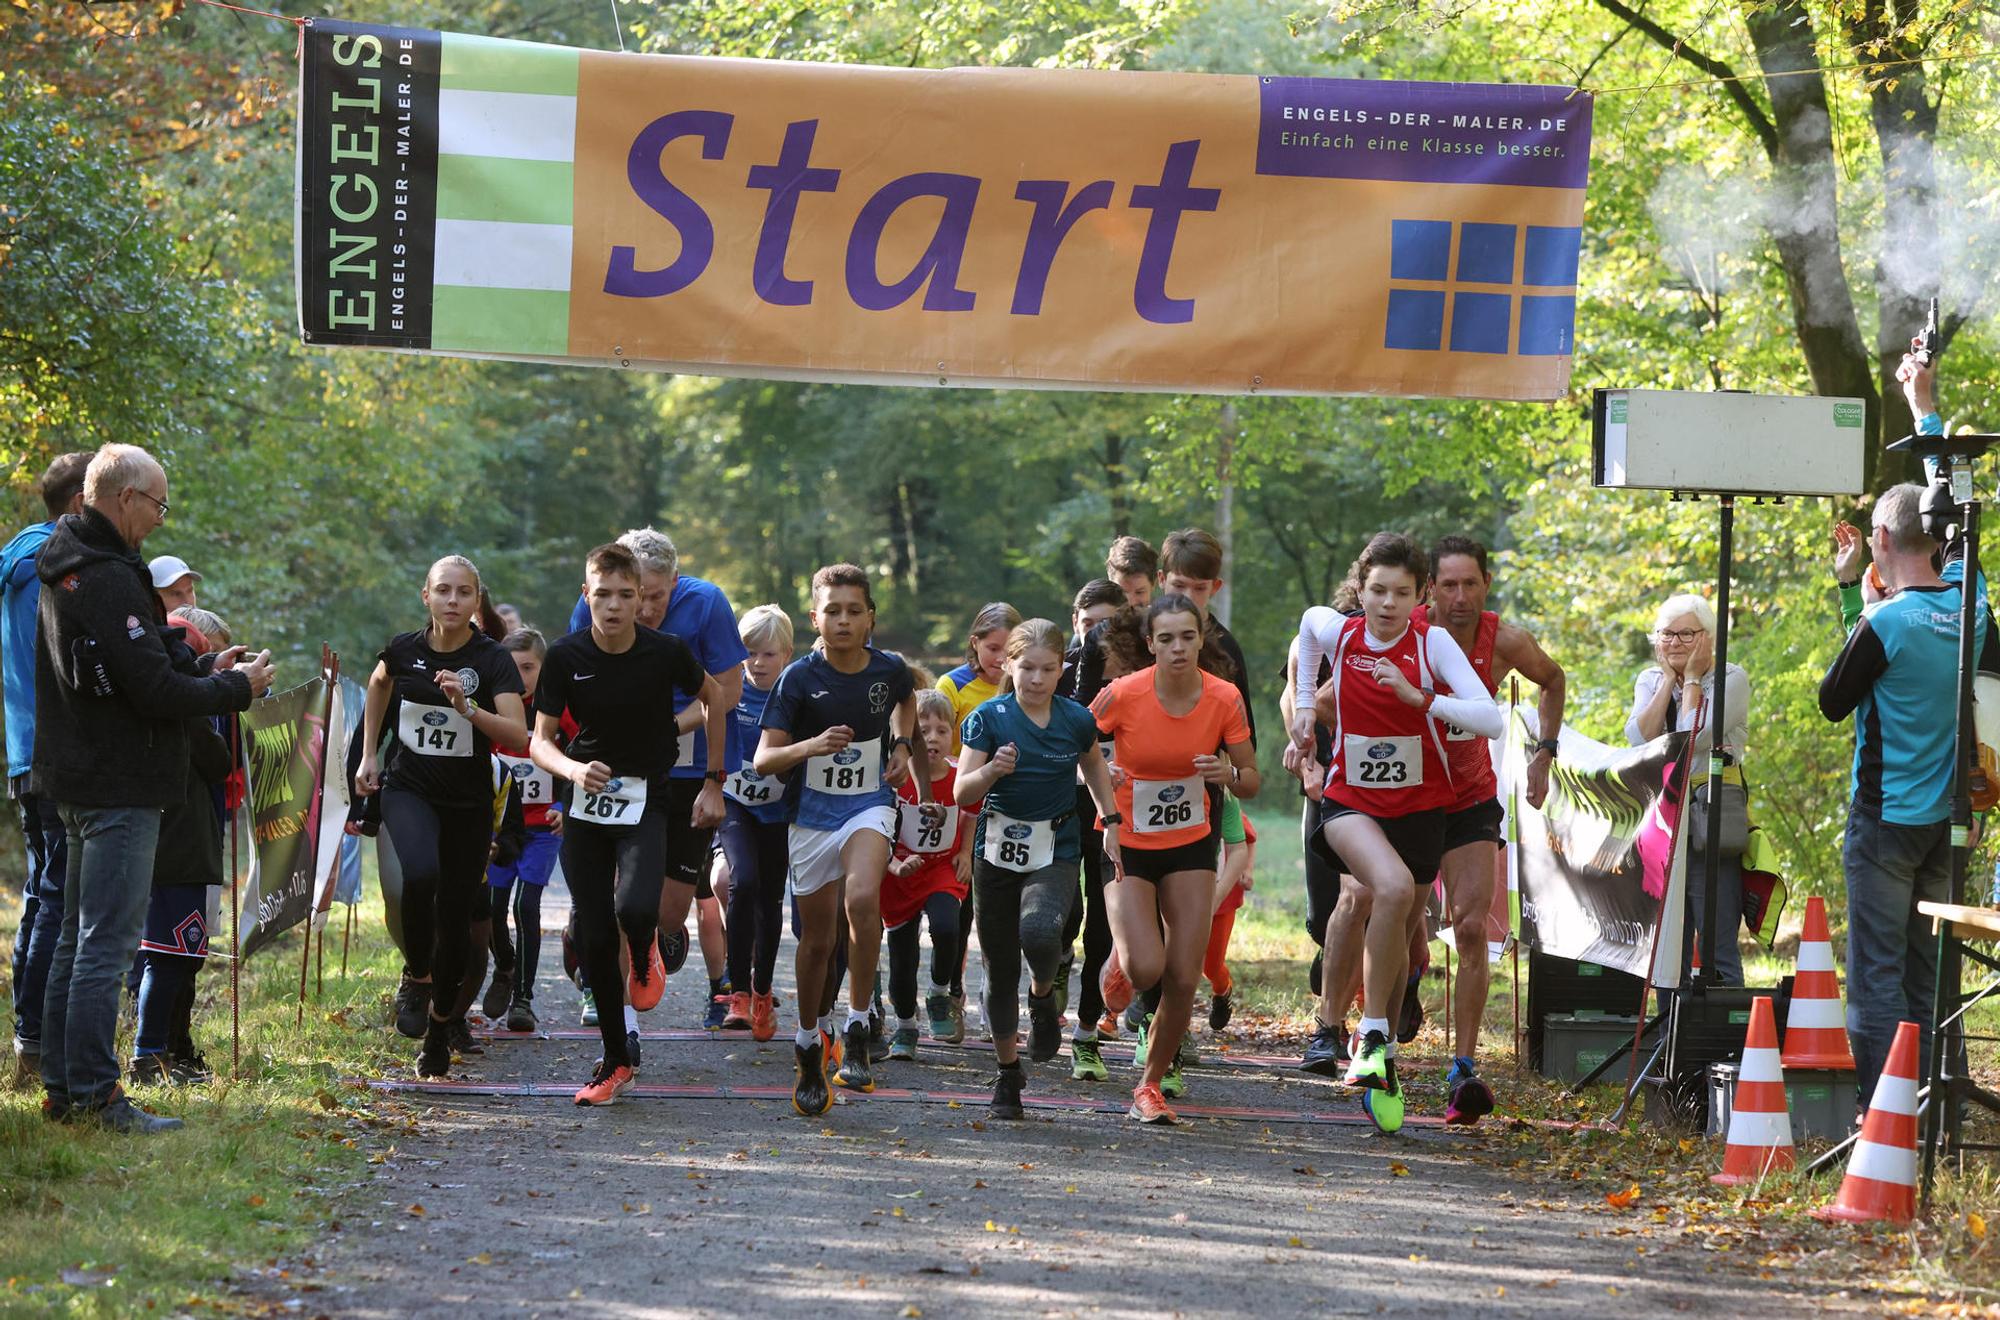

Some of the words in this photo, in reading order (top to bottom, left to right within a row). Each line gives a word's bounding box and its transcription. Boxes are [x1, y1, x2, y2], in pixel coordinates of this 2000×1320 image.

[1281, 131, 1354, 150] Einfach
[1367, 136, 1409, 152] eine
[1422, 138, 1484, 156] Klasse
[1498, 140, 1566, 159] besser.
[329, 34, 383, 331] ENGELS
[603, 109, 1222, 325] Start
[414, 726, 458, 751] 147
[822, 766, 866, 789] 181
[1359, 761, 1408, 783] 223
[734, 778, 771, 802] 144
[583, 791, 631, 819] 267
[1148, 800, 1192, 826] 266
[917, 828, 942, 848] 79
[1000, 840, 1031, 867] 85
